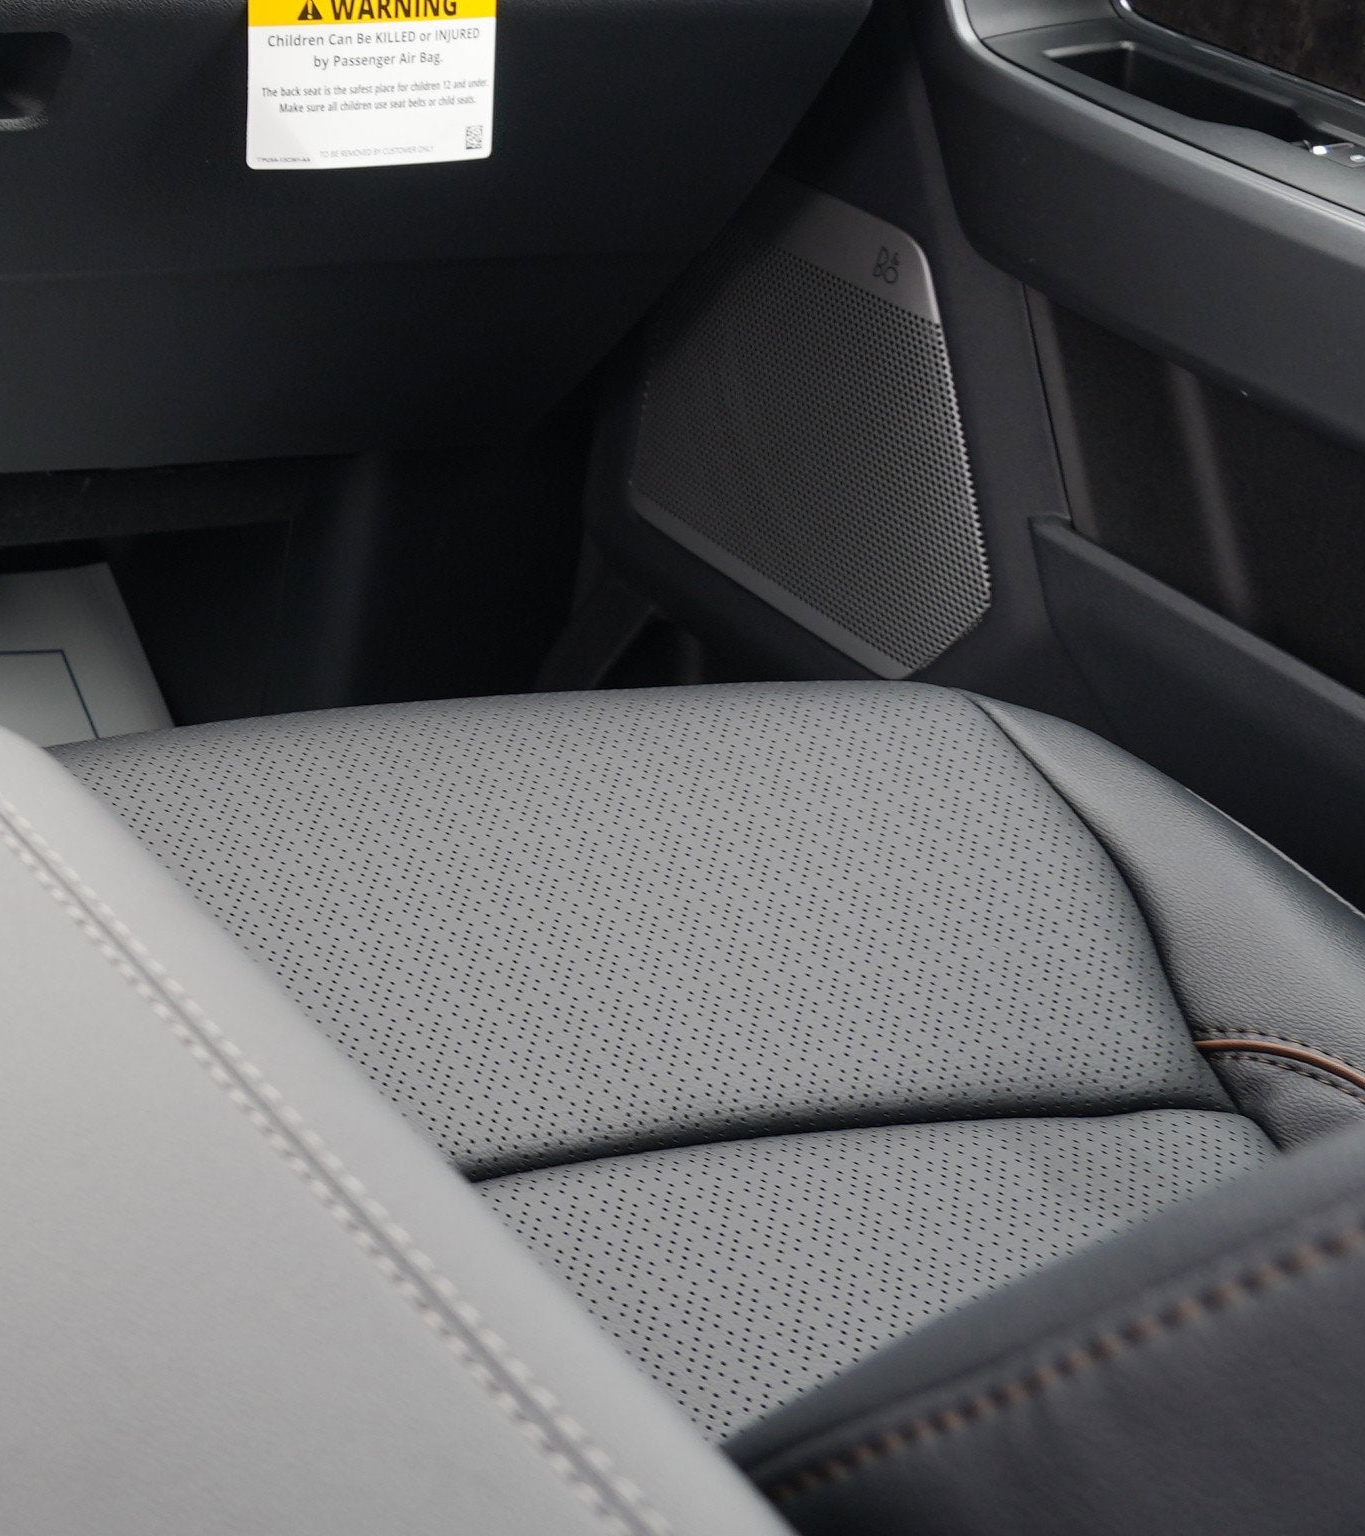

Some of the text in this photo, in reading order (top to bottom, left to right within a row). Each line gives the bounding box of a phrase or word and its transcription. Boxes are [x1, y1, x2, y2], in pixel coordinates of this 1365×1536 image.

[267, 28, 480, 48] Children Can Be KILLED or INJURED
[313, 51, 444, 70] by Passenger Air Bag.
[261, 87, 278, 97] The
[280, 86, 301, 97] back
[303, 87, 322, 96] seat
[324, 86, 331, 95] is
[333, 85, 347, 95] the
[349, 83, 373, 95] safest
[374, 83, 395, 96] place
[397, 82, 409, 93] for
[410, 81, 441, 92] children
[443, 80, 451, 89] 12
[453, 79, 467, 89] and
[279, 102, 304, 113] Make
[307, 103, 325, 112] sure
[327, 101, 338, 112] all
[340, 99, 372, 111] children
[374, 101, 388, 110] use
[390, 99, 406, 109] seat
[408, 97, 426, 108] belts
[428, 98, 436, 107] or
[438, 95, 455, 106] child
